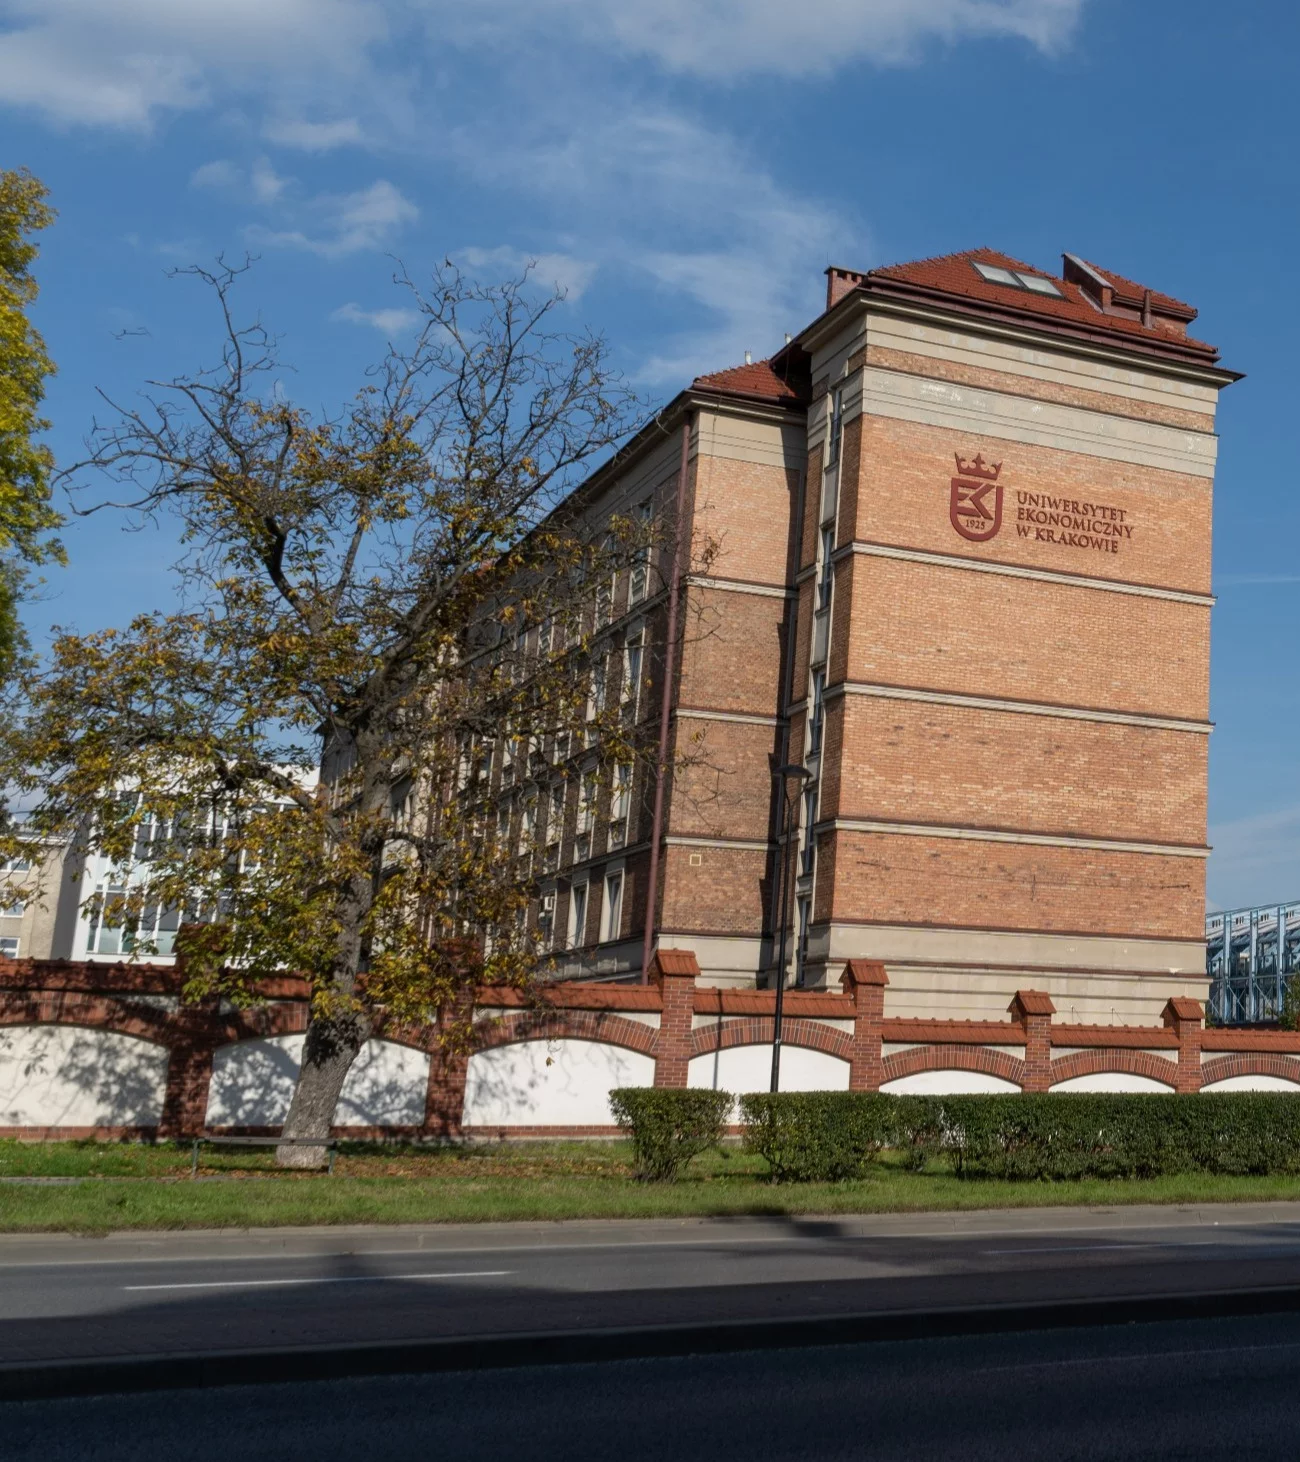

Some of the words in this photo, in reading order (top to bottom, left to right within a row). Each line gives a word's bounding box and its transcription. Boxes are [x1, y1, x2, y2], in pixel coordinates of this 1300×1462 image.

[1017, 491, 1127, 522] UNIWERSYTET
[965, 519, 986, 529] 1925
[1018, 507, 1134, 538] EKONOMICZNY
[1016, 524, 1030, 537] W
[1035, 529, 1119, 553] KRAKOWIE
